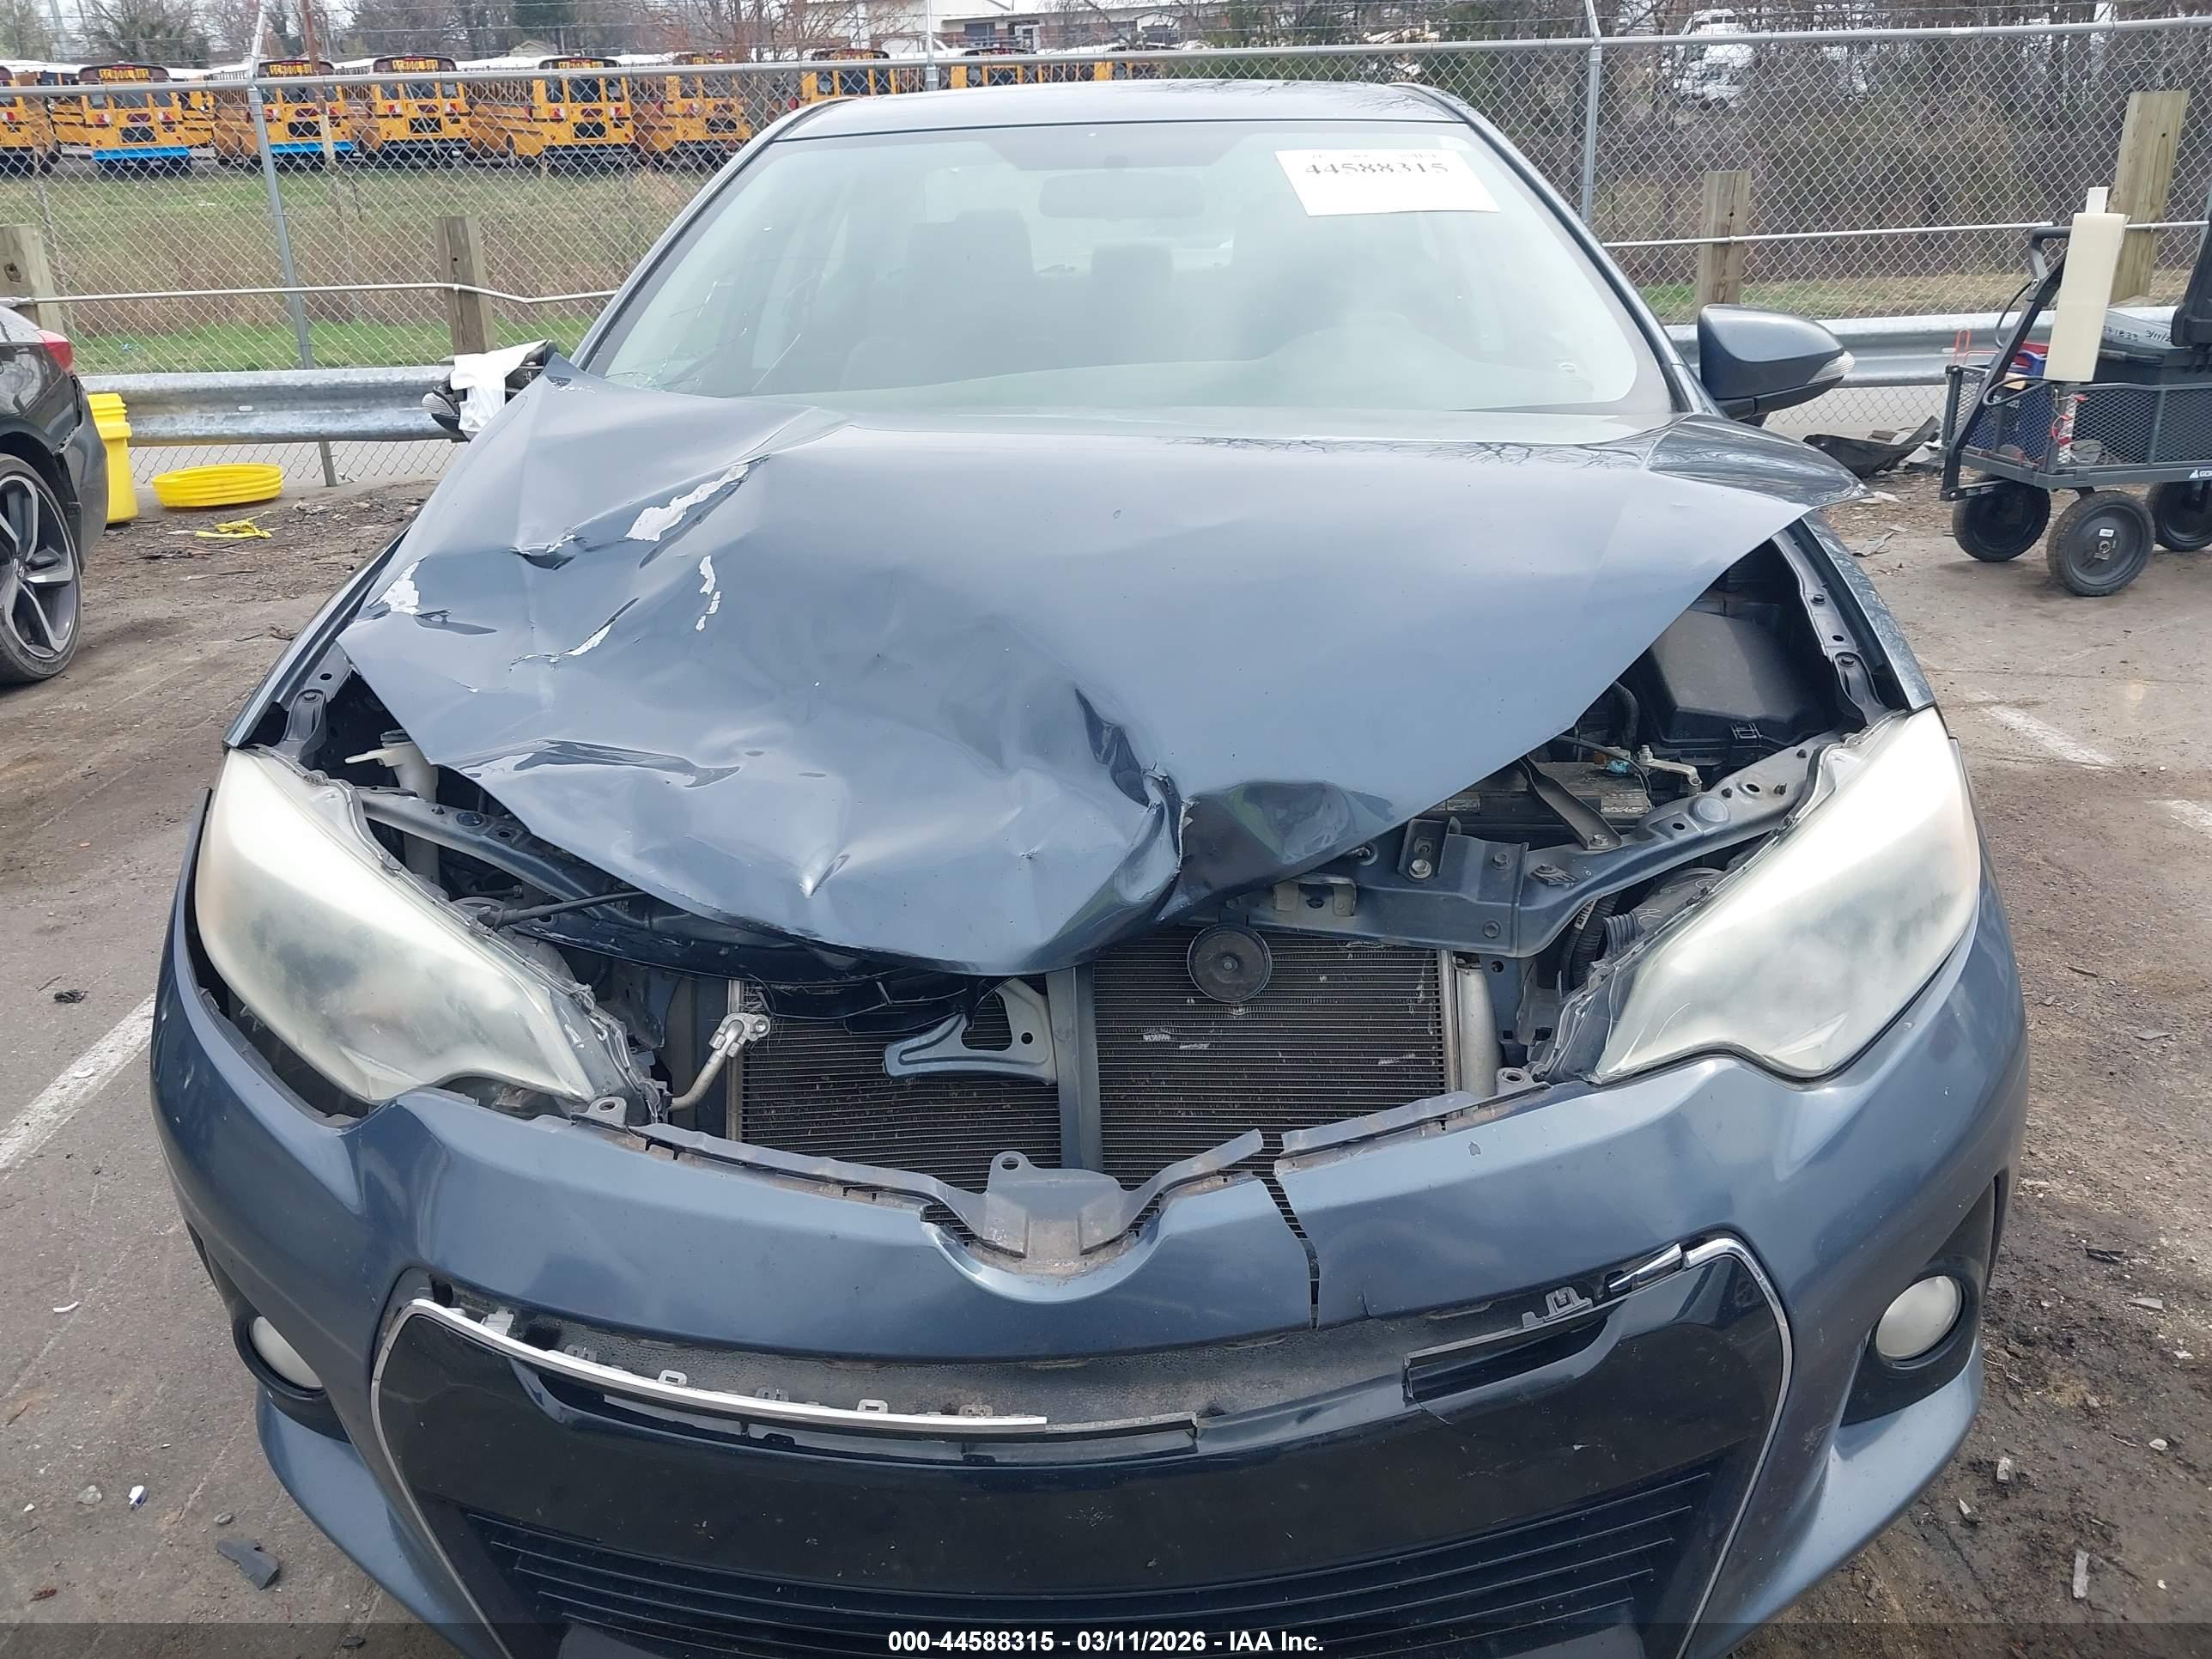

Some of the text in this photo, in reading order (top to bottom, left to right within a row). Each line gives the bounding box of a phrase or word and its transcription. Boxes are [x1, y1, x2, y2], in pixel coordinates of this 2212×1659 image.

[100, 69, 149, 79] SCHOOL BUS
[270, 64, 300, 75] SCHOOL
[2145, 330, 2172, 343] 3/11/2
